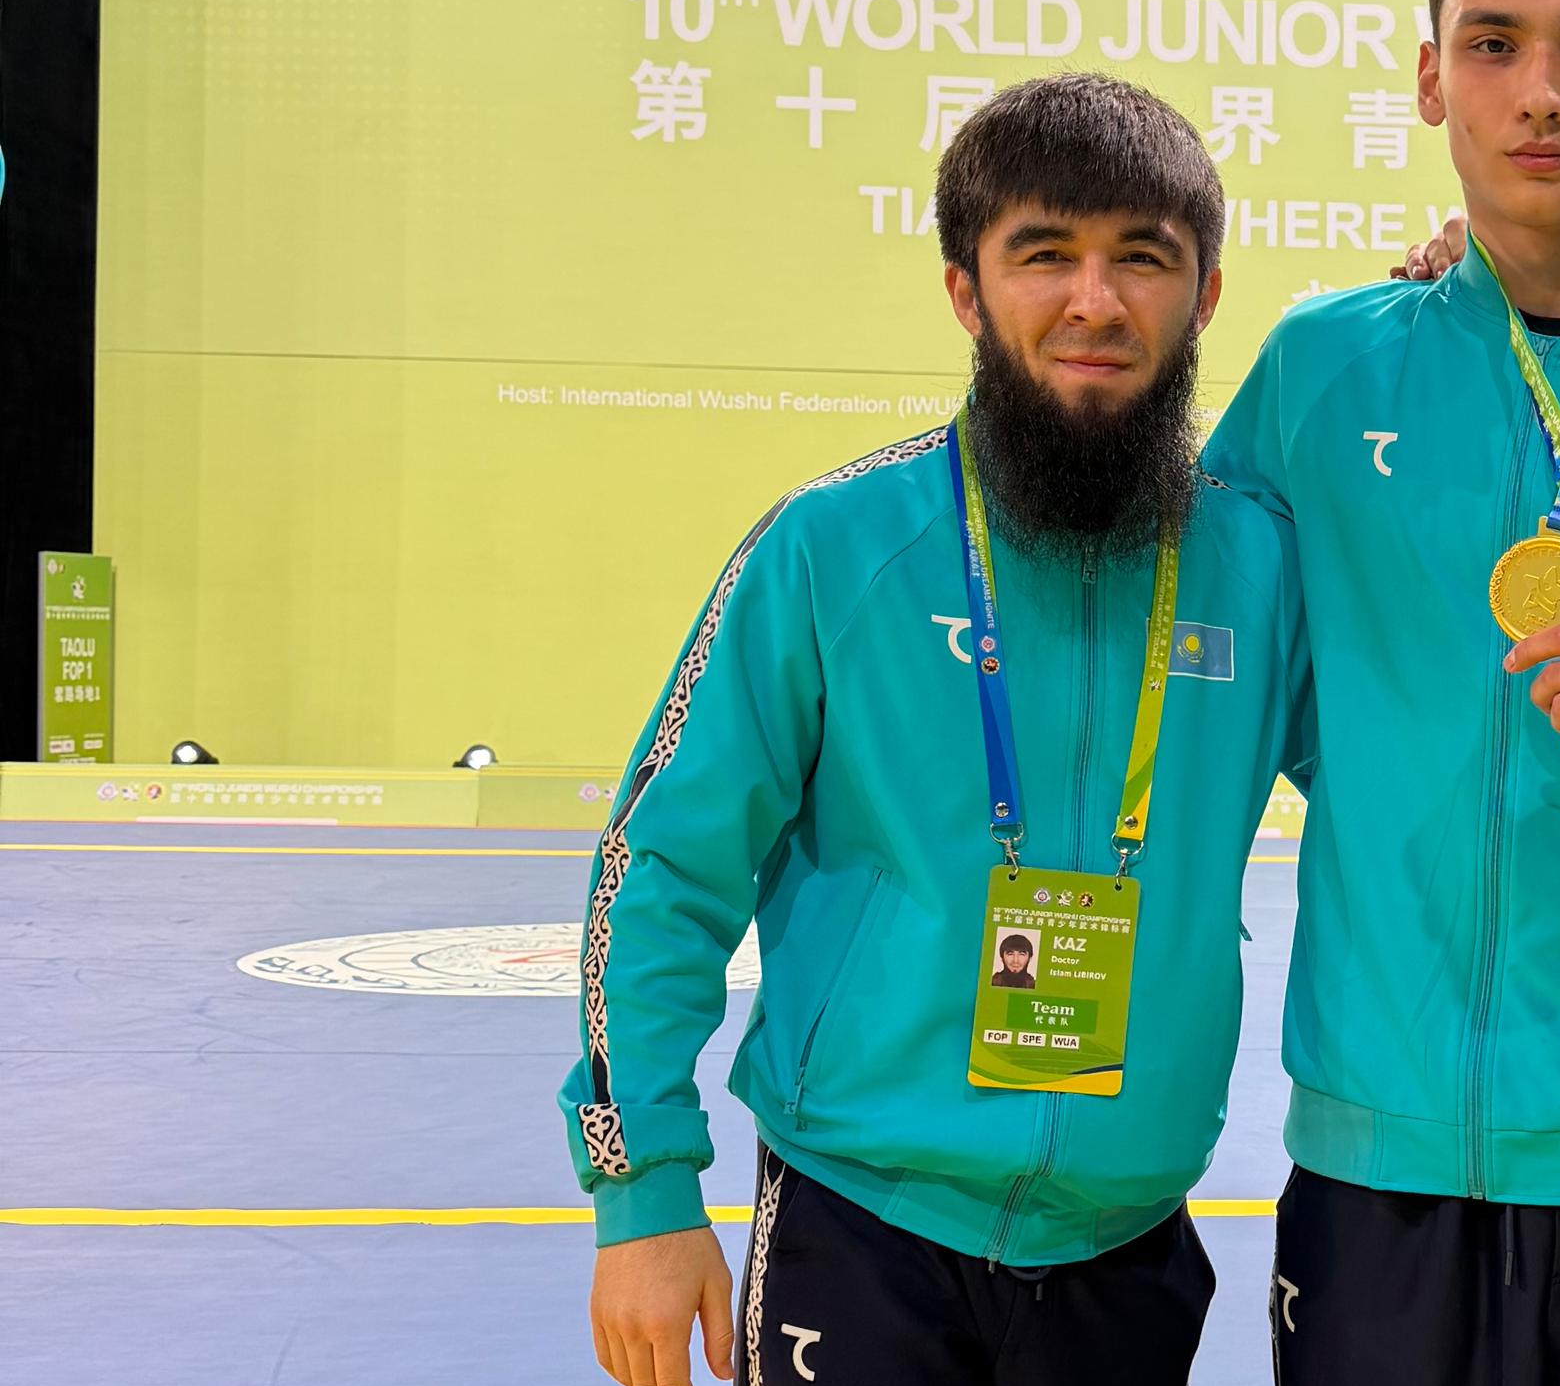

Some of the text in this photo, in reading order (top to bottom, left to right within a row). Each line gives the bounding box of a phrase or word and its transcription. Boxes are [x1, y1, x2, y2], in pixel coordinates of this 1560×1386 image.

[497, 383, 554, 406] Host:
[560, 386, 692, 410] International
[698, 389, 773, 413] Wushu
[779, 391, 892, 415] Federation
[60, 638, 96, 658] TAOLU
[62, 661, 93, 681] FOP 1
[1053, 935, 1088, 952] KAZ
[1051, 955, 1080, 965] Doctor
[1049, 968, 1072, 978] Islam
[1031, 1000, 1076, 1017] Team
[987, 1031, 1009, 1041] FOP
[1022, 1034, 1042, 1045] SPE
[1053, 1037, 1078, 1048] WUA
